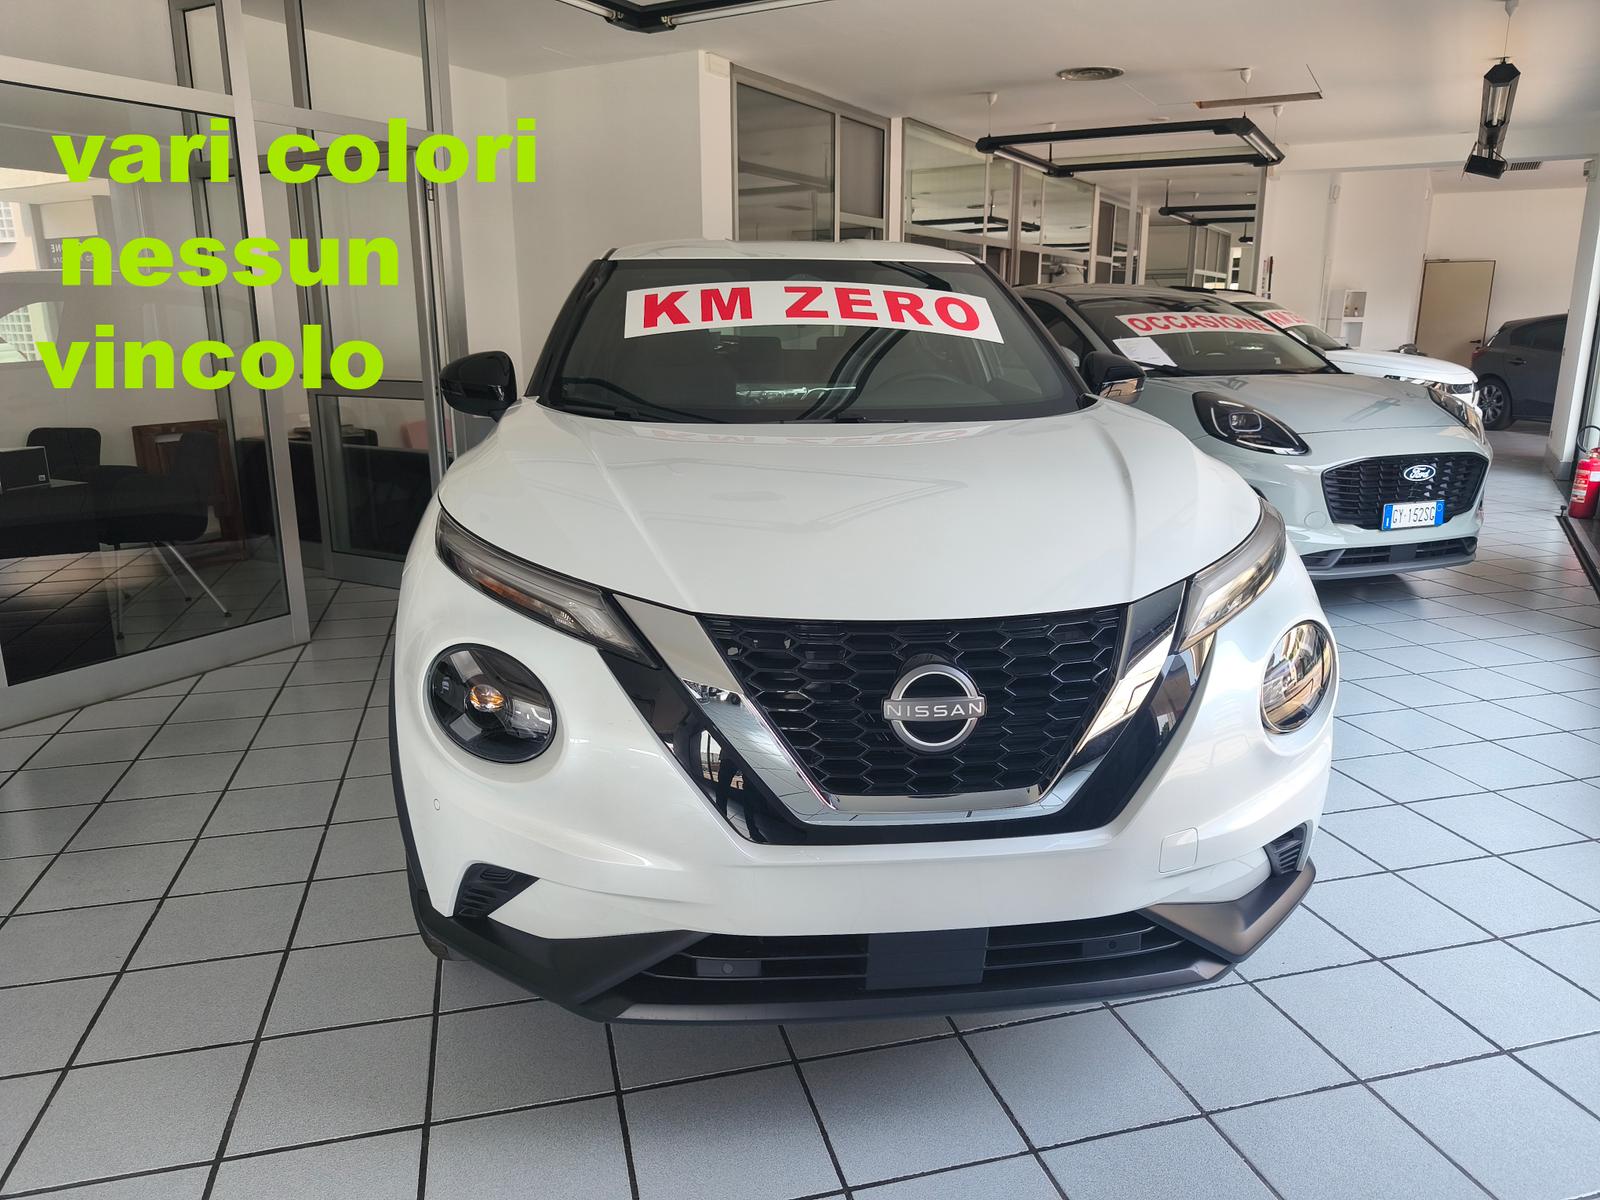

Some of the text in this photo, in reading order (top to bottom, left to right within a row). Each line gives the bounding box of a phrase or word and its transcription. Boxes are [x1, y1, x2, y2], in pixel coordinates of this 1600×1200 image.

[643, 286, 980, 331] KM ZERO
[1127, 315, 1275, 332] OCCASIONE
[886, 702, 983, 718] NISSAN
